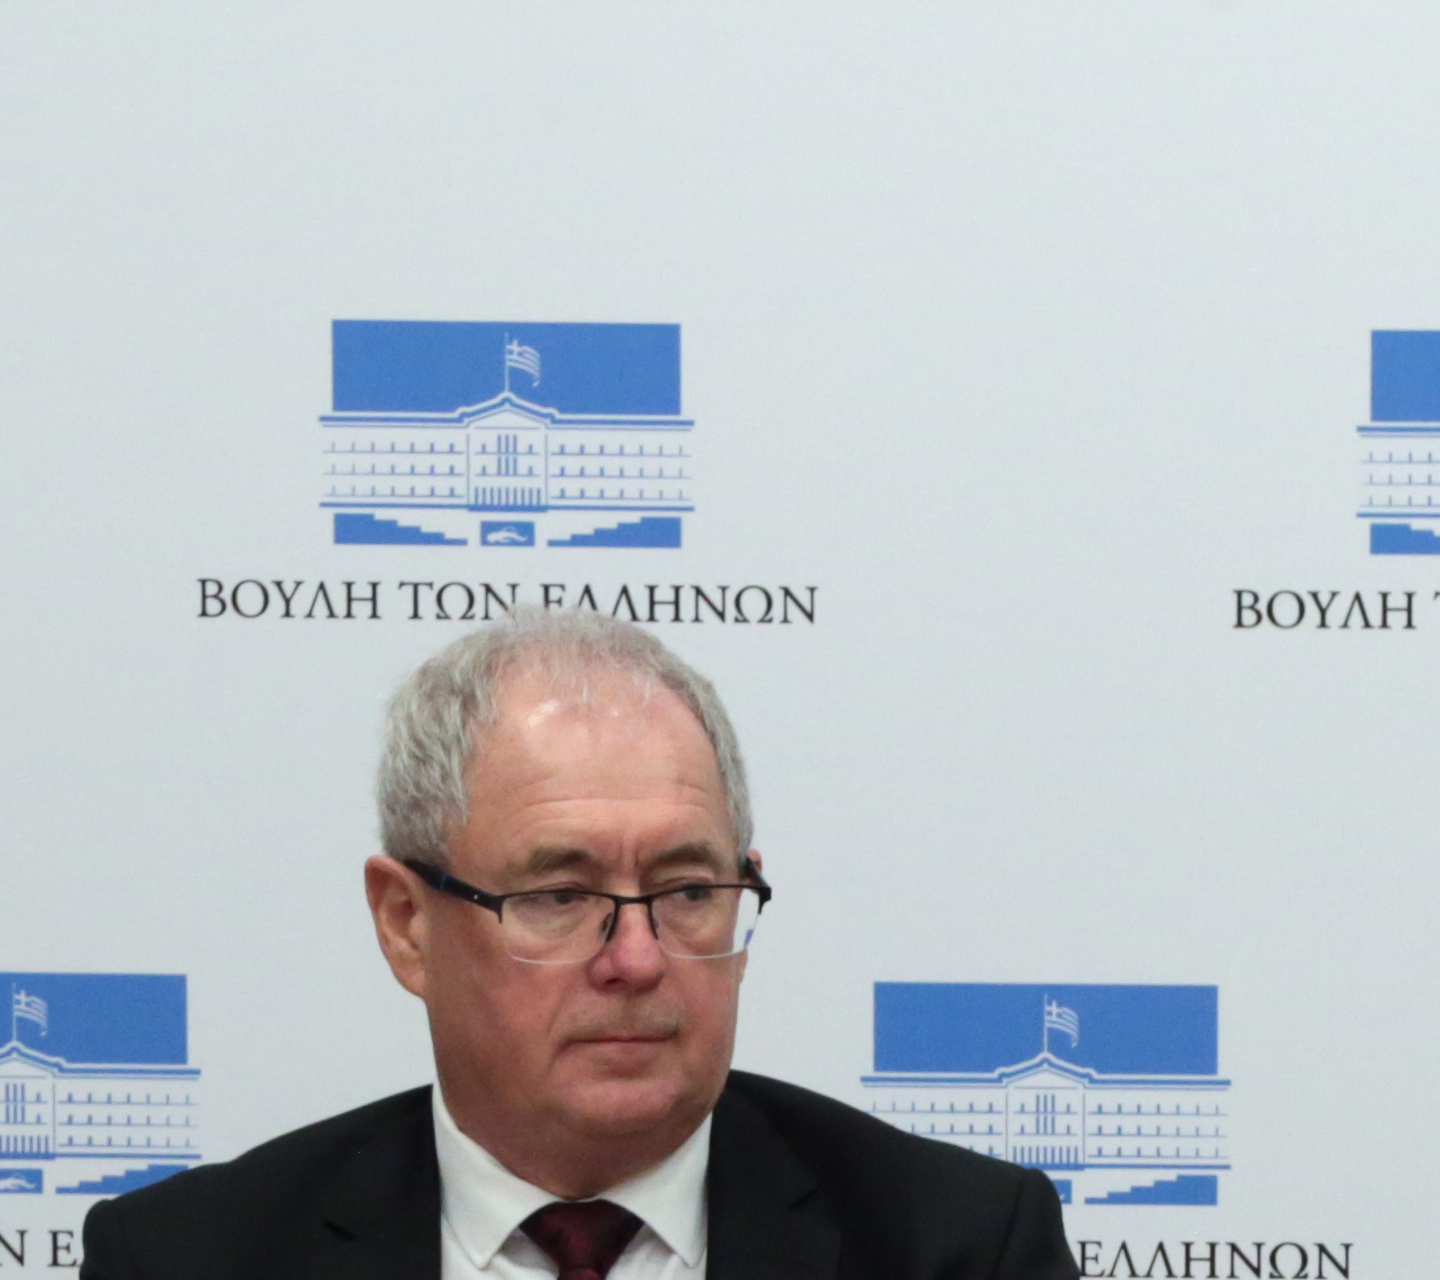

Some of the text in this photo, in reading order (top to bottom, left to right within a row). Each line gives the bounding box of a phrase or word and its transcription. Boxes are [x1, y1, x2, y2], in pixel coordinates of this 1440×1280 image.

[197, 577, 381, 620] ΒΟΥΛΗ
[397, 580, 521, 621] ΤΩΝ
[1233, 589, 1415, 630] ΒΟΥΛΗ
[1077, 1239, 1354, 1280] ΕΛΛΗΝΩΝ
